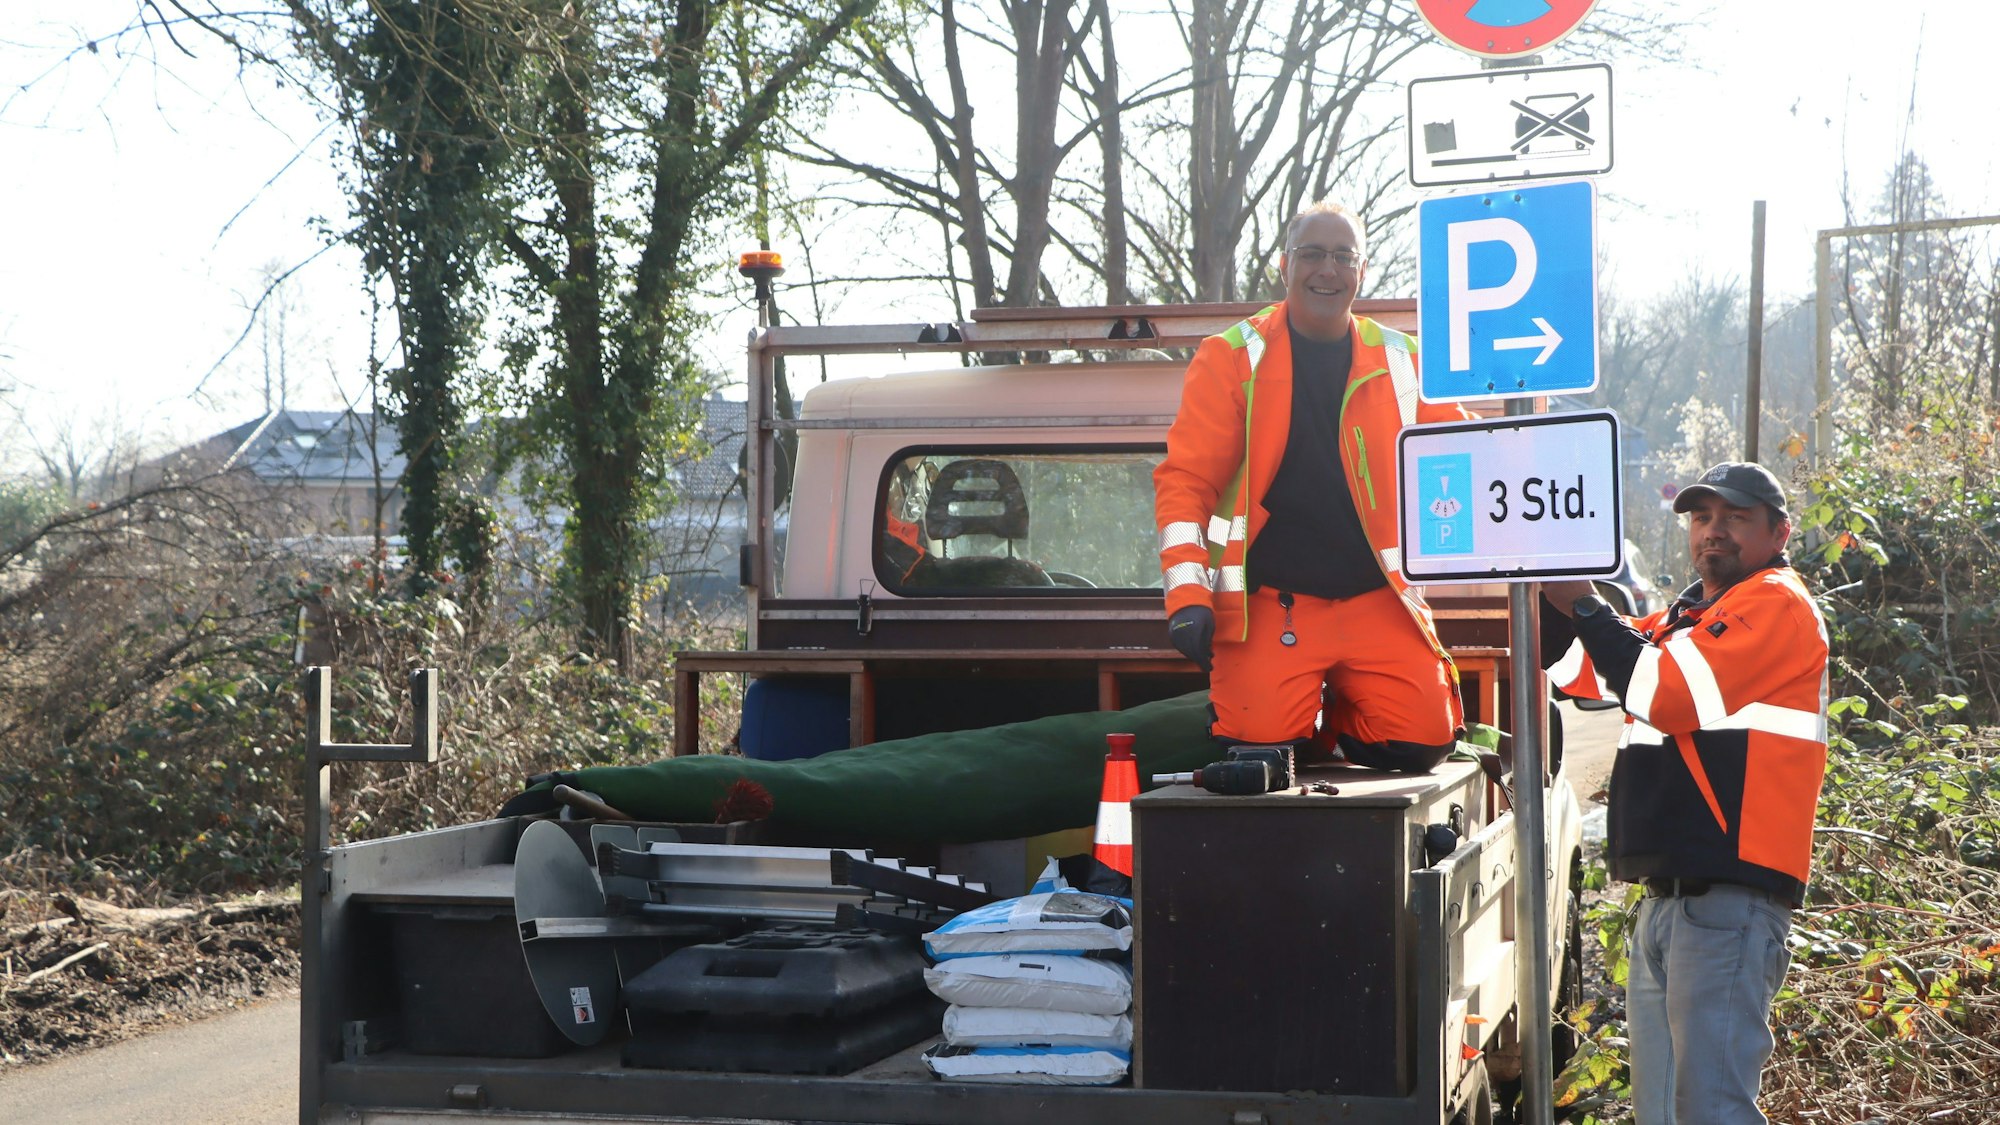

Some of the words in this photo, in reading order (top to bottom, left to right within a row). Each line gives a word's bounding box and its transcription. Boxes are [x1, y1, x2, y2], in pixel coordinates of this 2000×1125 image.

[1447, 217, 1538, 372] P
[1488, 479, 1508, 523] 3
[1521, 474, 1595, 522] Std.
[1440, 524, 1452, 545] P
